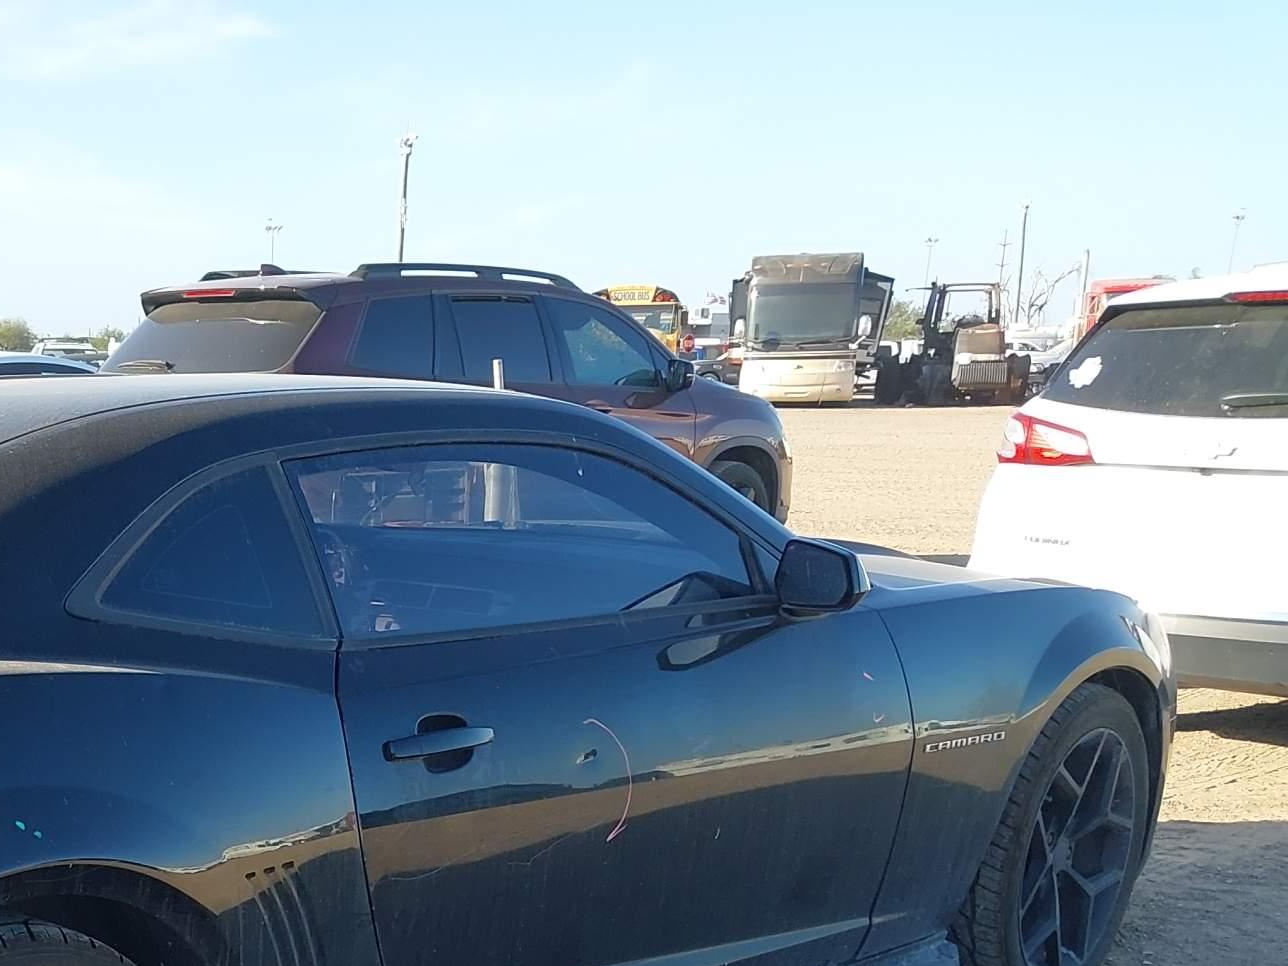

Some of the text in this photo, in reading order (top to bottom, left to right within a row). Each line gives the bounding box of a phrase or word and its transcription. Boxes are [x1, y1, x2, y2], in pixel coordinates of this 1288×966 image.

[614, 291, 650, 301] SCHOOL BUS
[925, 731, 1006, 753] CAMARO
